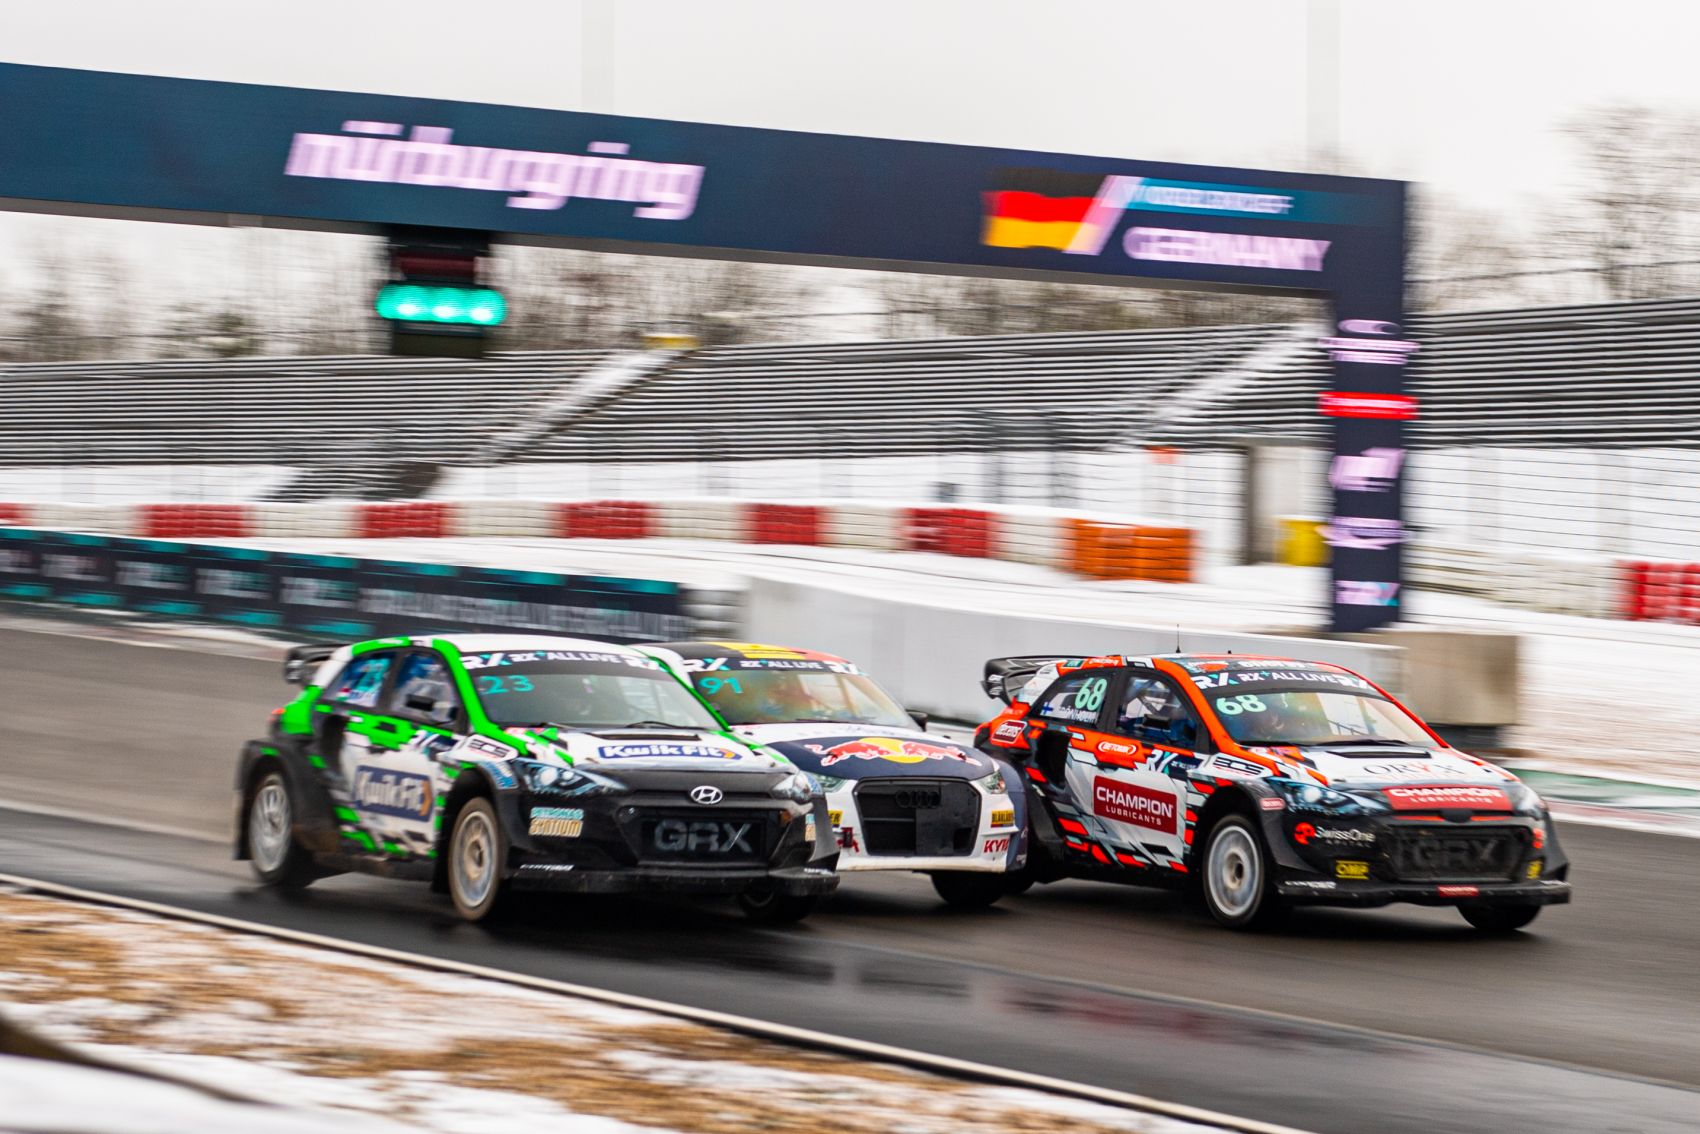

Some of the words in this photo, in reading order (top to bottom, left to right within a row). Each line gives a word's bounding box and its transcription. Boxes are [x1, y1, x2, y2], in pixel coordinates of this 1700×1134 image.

[1123, 226, 1331, 271] GERMANY
[479, 675, 534, 695] 23
[700, 676, 743, 694] 91
[1190, 672, 1239, 690] RX
[1271, 673, 1300, 682] ALL
[1301, 673, 1337, 684] LIVE
[1074, 677, 1107, 711] 68
[1216, 694, 1267, 715] 68
[1096, 787, 1173, 818] CHAMPION
[1388, 787, 1503, 798] CHAMPION
[1106, 805, 1162, 826] LUBRICANTS
[655, 819, 753, 853] GRX
